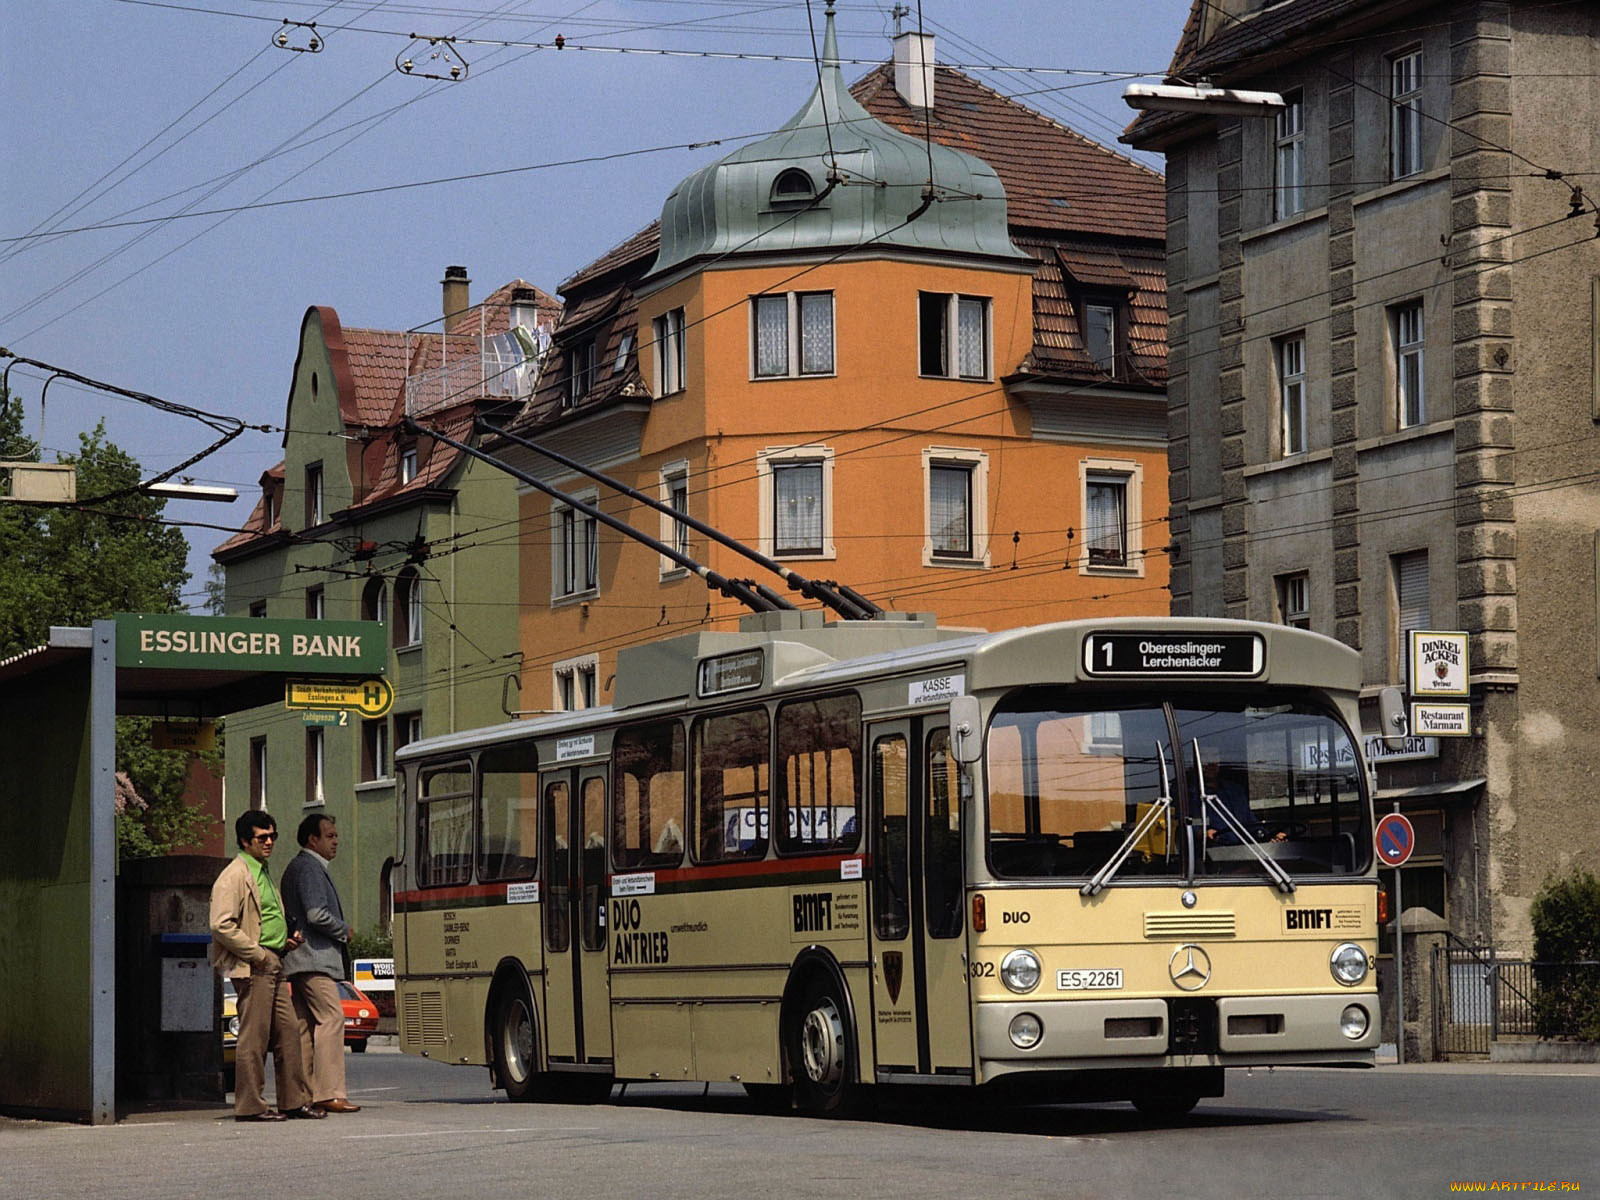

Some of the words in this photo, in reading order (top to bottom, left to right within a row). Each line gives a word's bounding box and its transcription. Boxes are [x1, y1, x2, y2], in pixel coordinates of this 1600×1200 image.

[140, 630, 281, 655] ESSLINGER
[292, 635, 361, 657] BANK
[1138, 641, 1226, 656] Oberesslingen-
[1422, 639, 1461, 654] DINKEL
[1101, 641, 1113, 667] 1
[1142, 655, 1222, 668] Lerchenäcker
[1424, 650, 1459, 666] ACKER
[922, 677, 951, 692] KASSE
[364, 686, 381, 705] H
[339, 711, 348, 726] 2
[1420, 710, 1464, 720] Restaurant
[1423, 720, 1462, 730] Marmara
[613, 899, 641, 931] DUO
[1003, 912, 1030, 924] DUO
[614, 931, 669, 964] ANTRIEB
[970, 961, 995, 977] 302
[1061, 971, 1119, 987] ES-2261
